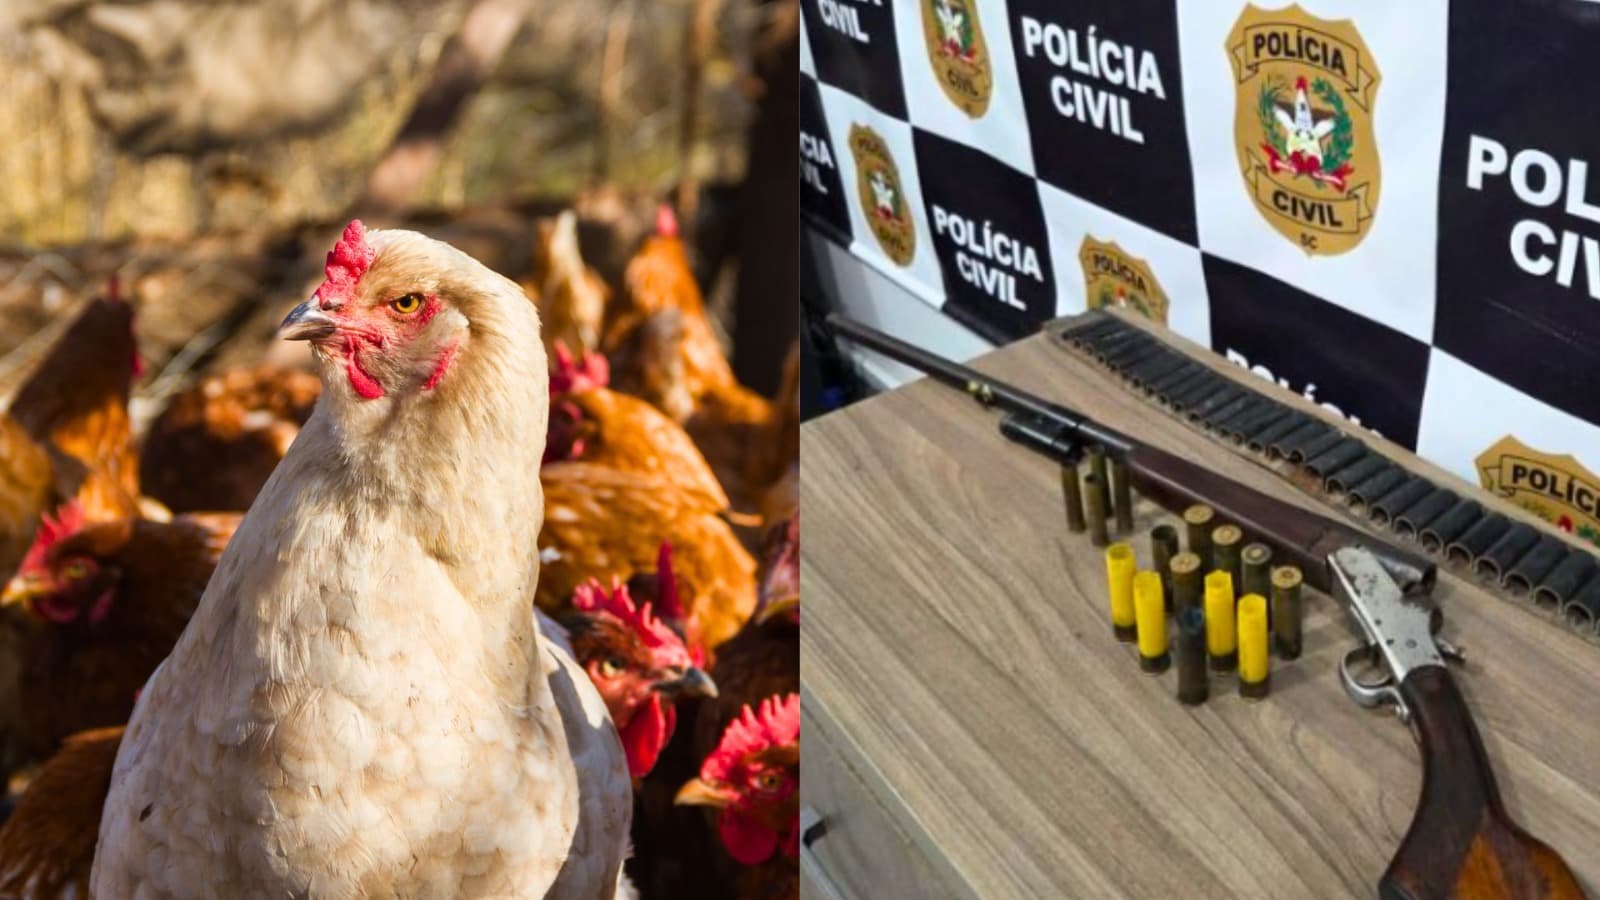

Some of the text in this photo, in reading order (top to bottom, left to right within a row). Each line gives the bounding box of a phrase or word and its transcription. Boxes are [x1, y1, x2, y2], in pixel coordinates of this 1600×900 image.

[818, 0, 869, 43] CIVIL
[1021, 16, 1166, 99] POLÍCIA
[1253, 29, 1347, 76] POLÍCIA
[1051, 77, 1145, 144] CIVIL
[1272, 189, 1343, 227] CIVIL
[932, 205, 1043, 282] POLÍCIA
[956, 253, 1026, 311] CIVIL
